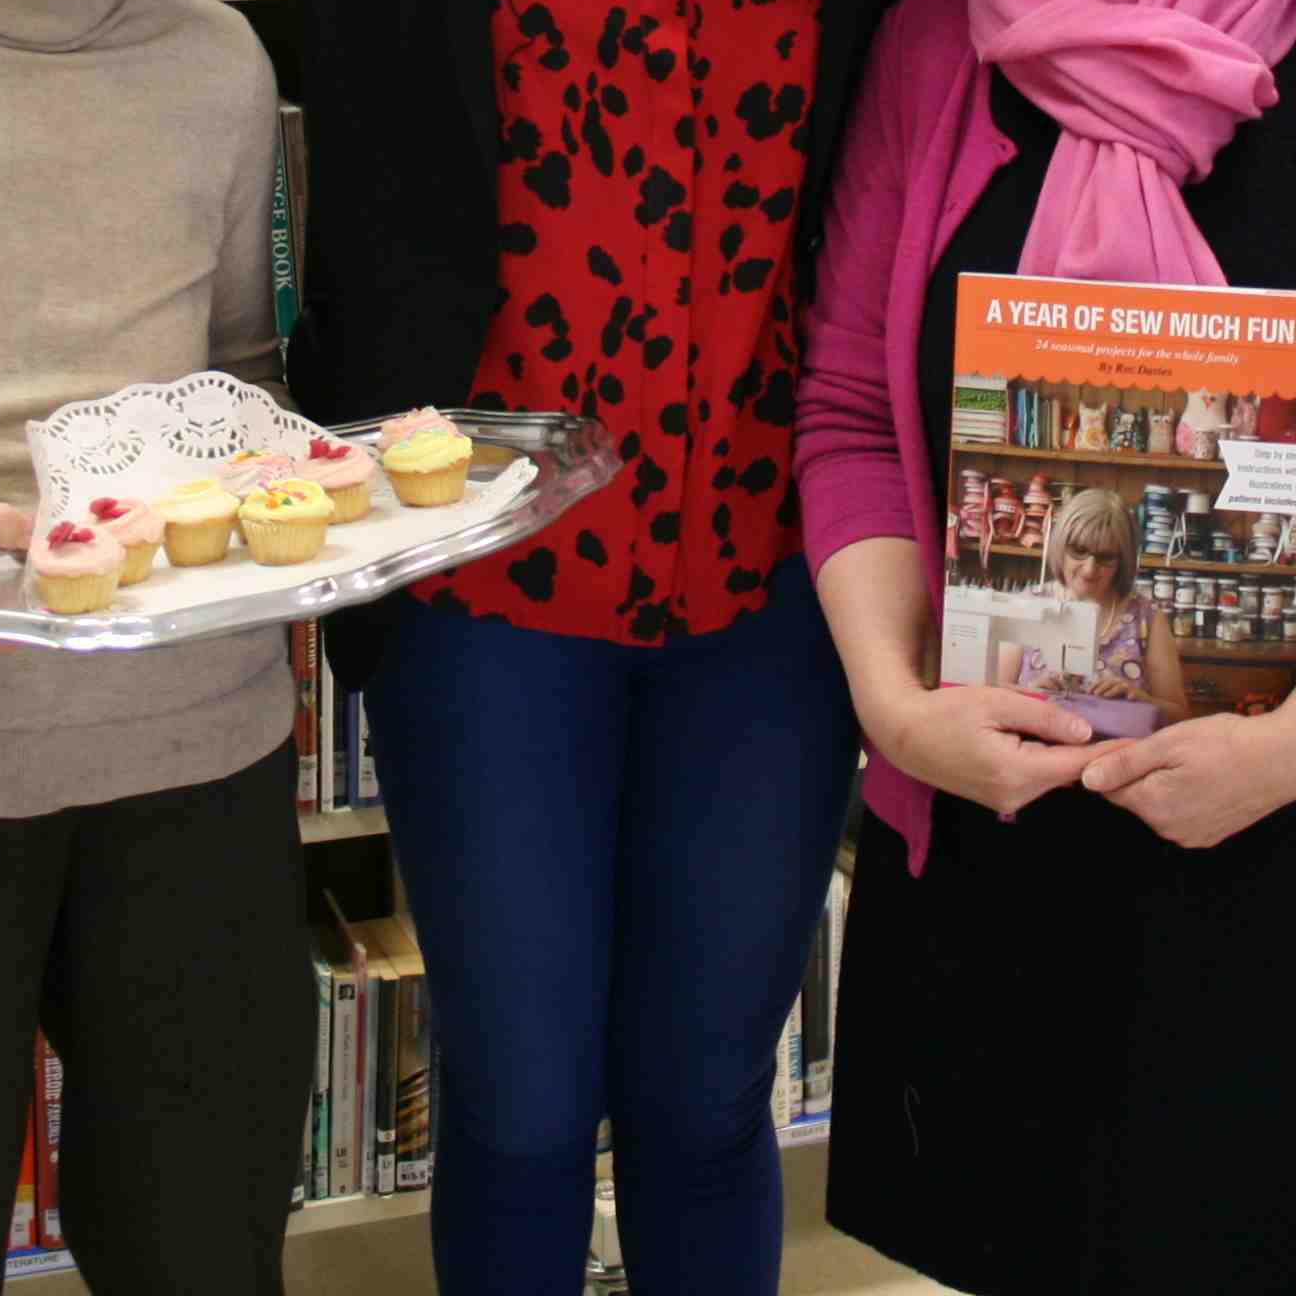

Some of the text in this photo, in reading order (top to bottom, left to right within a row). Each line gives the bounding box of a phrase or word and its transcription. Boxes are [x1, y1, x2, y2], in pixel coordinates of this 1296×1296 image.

[272, 228, 293, 290] BOOK
[986, 299, 1296, 344] A YEAR OF SEW MUCH FUN
[1035, 338, 1240, 365] 24 seasonal projects for the whole family
[1098, 362, 1113, 375] By
[44, 1057, 63, 1101] HEROIC
